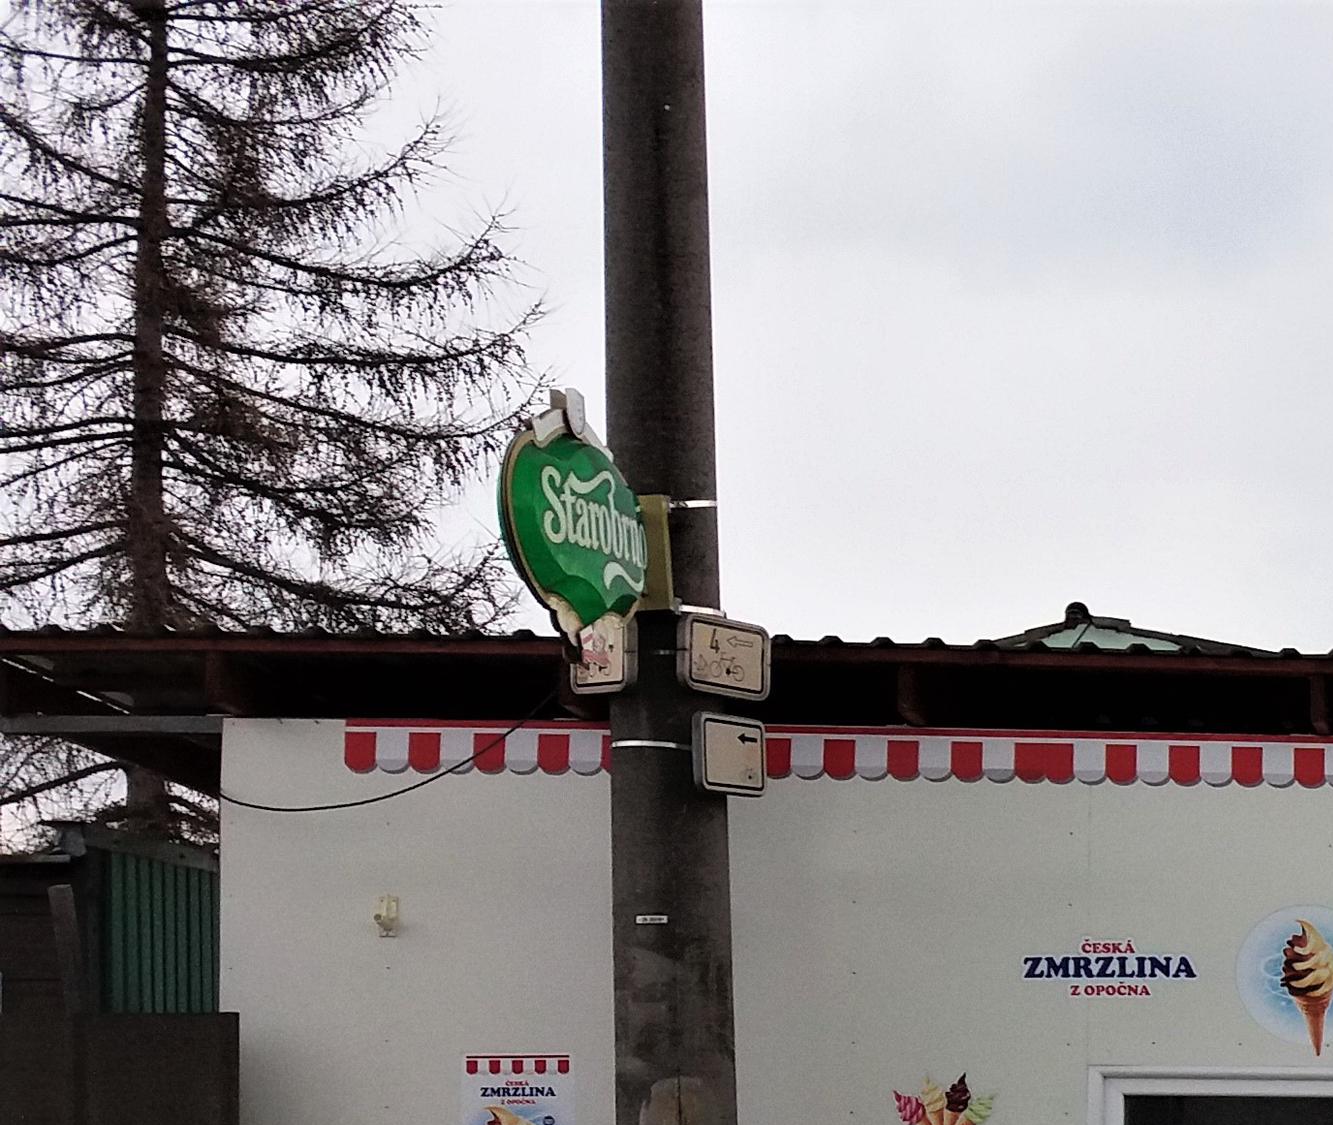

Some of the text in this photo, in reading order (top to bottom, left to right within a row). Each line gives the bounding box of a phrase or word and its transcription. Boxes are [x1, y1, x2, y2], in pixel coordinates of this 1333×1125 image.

[540, 465, 648, 592] Starobrno
[709, 628, 720, 653] 4
[1081, 939, 1135, 953] ČESKÁ
[1023, 956, 1197, 978] ZMRZLINA
[1070, 982, 1151, 996] Z OPOČNA
[480, 1086, 556, 1097] ZMRZLINA
